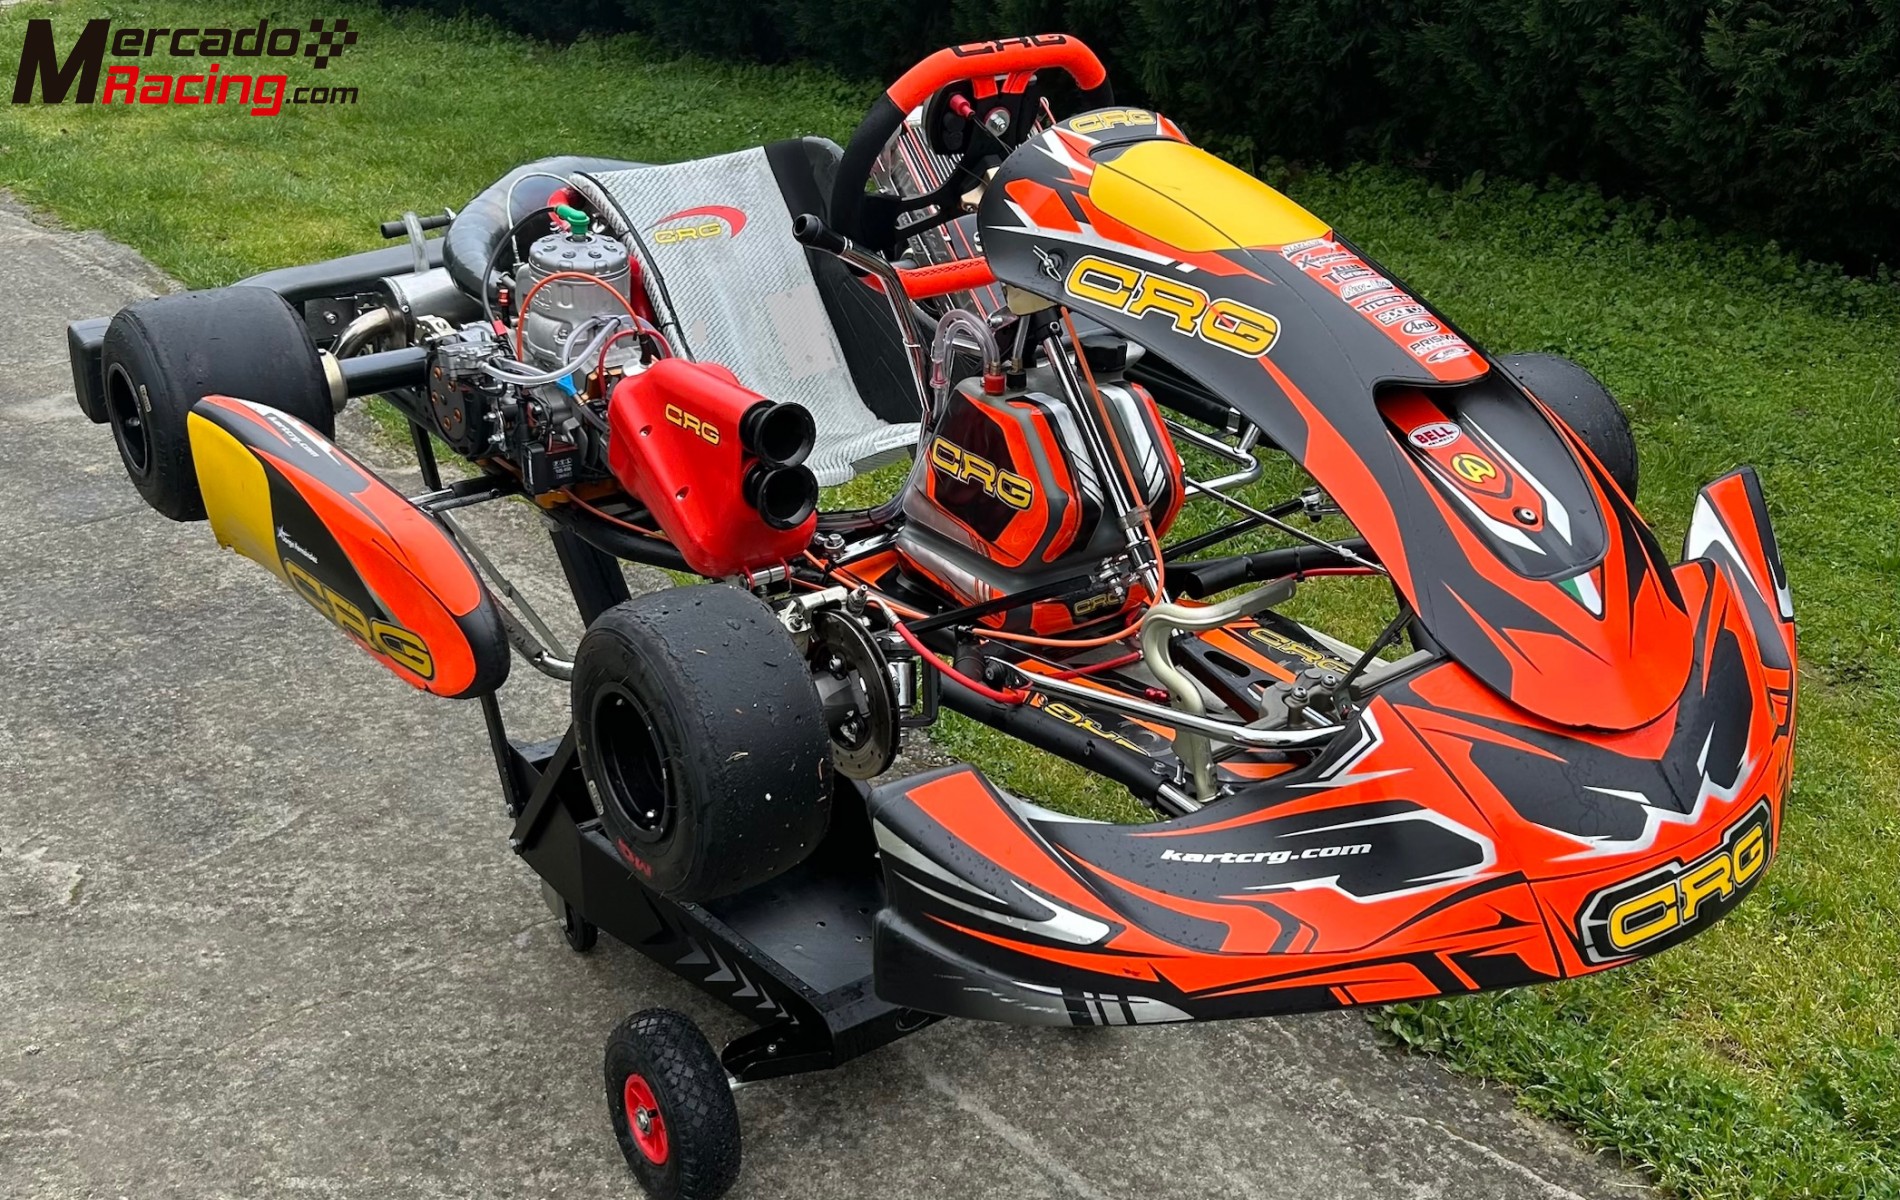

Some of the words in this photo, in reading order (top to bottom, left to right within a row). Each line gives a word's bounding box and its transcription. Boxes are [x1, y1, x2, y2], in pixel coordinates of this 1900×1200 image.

[1069, 109, 1156, 134] CRG
[656, 222, 721, 244] CRG
[1065, 255, 1280, 358] CRG
[665, 402, 720, 446] CRG
[1414, 426, 1454, 444] BELL
[932, 435, 1034, 511] CRG
[284, 558, 435, 682] CRG
[1160, 843, 1372, 865] kartcrg.com
[1607, 822, 1766, 953] CRG
